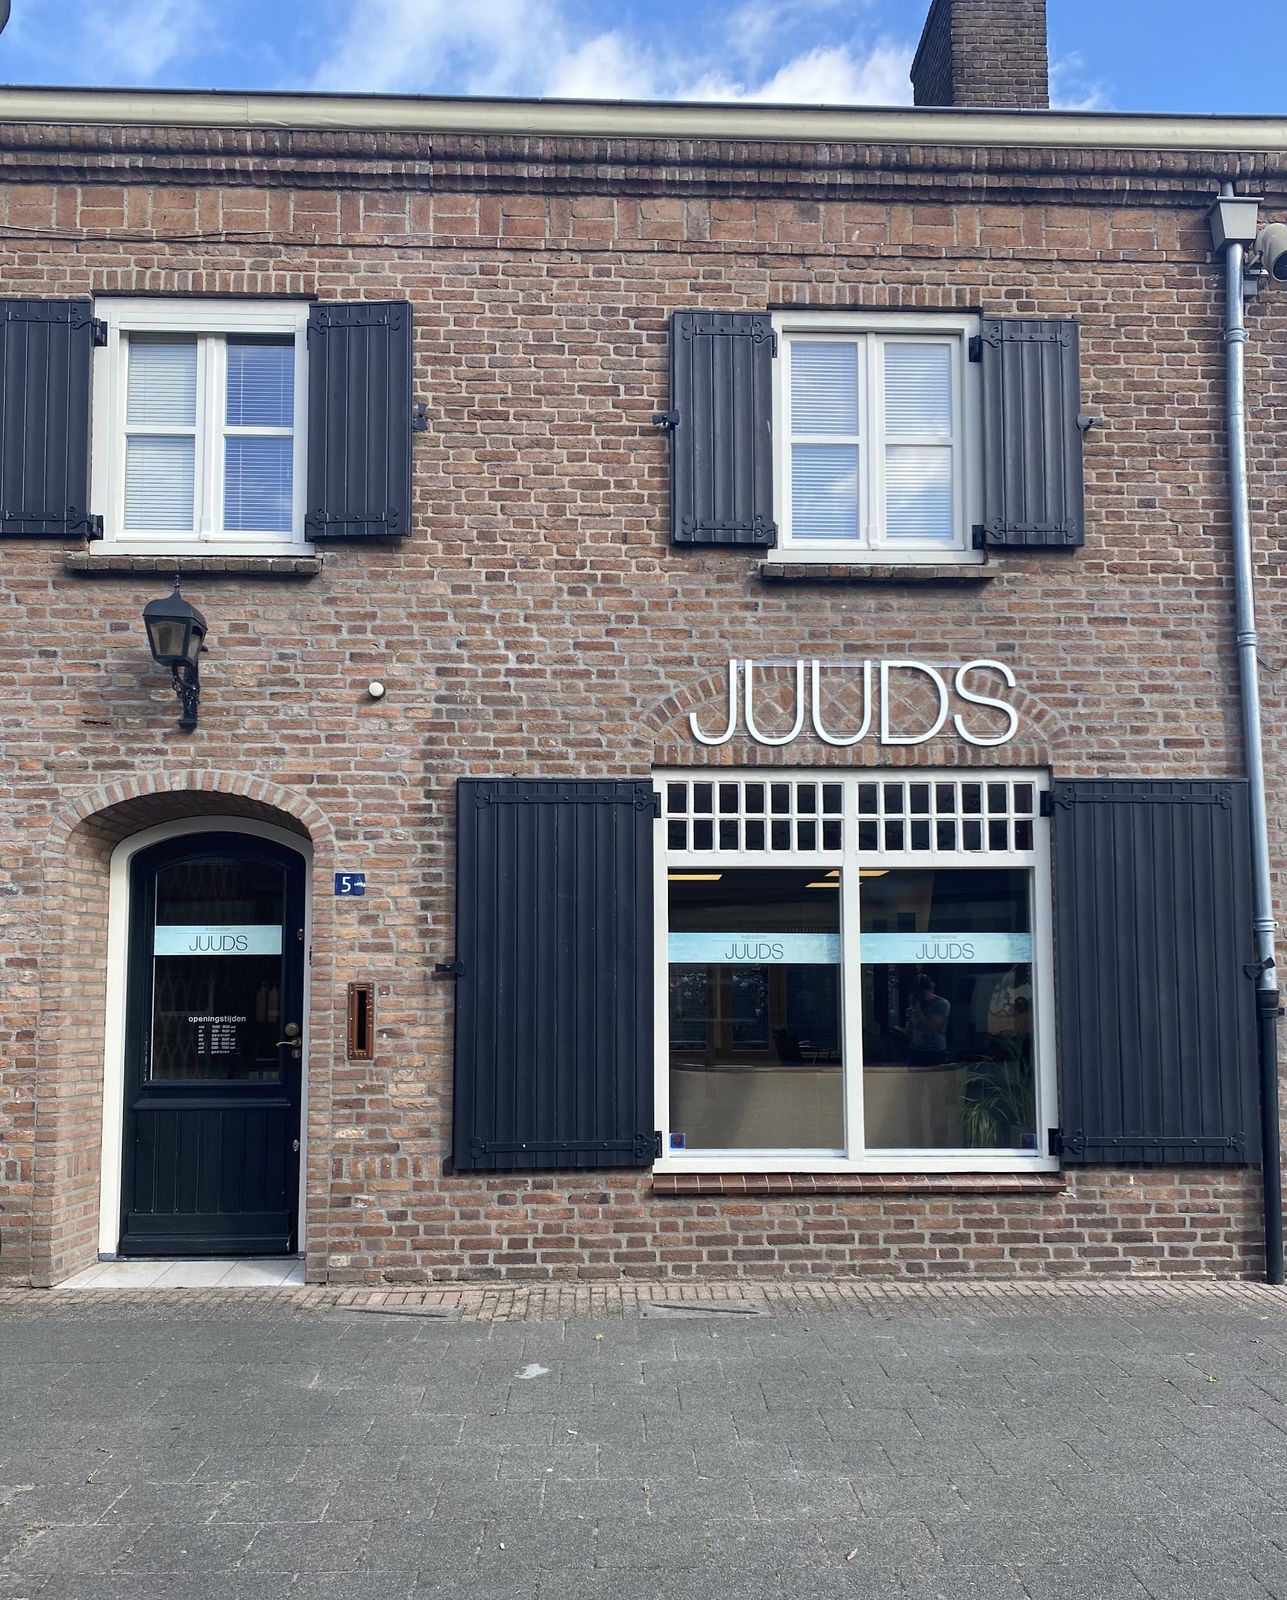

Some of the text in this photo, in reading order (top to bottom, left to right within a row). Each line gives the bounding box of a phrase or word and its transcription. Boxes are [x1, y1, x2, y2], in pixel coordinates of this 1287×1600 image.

[689, 659, 1018, 746] JUUDS
[341, 876, 352, 893] 5
[188, 935, 248, 952] JUUDS
[725, 943, 784, 960] JUUDS
[915, 943, 975, 960] JUUDS
[188, 1015, 247, 1024] openingstijden
